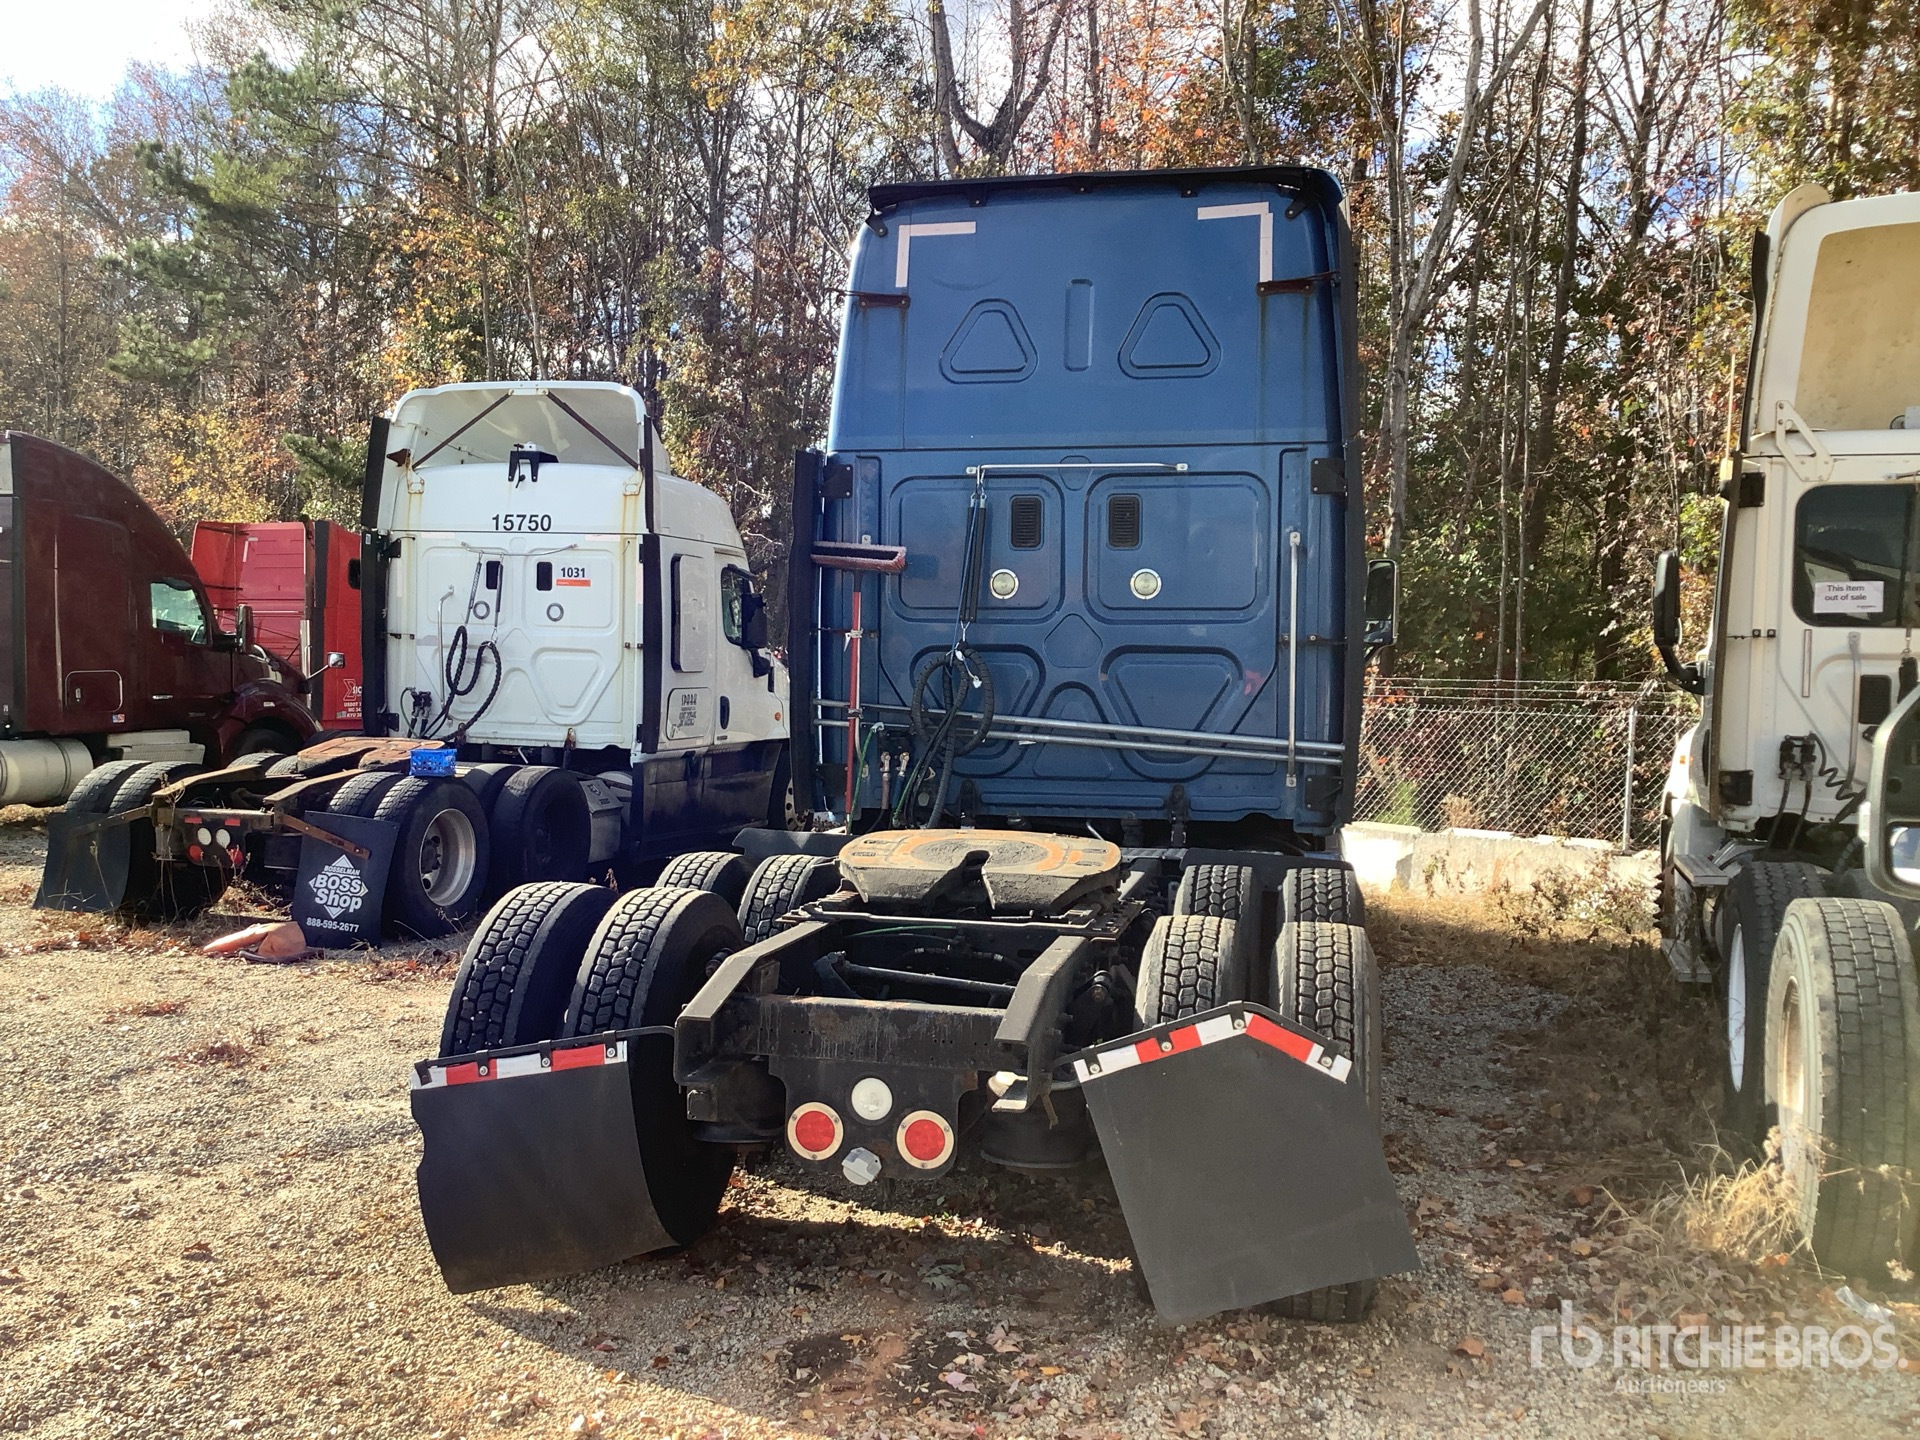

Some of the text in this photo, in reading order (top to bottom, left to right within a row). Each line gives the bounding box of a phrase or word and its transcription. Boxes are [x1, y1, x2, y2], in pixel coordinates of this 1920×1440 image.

[492, 513, 552, 532] 15750
[560, 567, 586, 578] 1031
[324, 865, 360, 875] BOSSELMAN
[314, 888, 363, 913] Shop
[306, 917, 359, 932] 888-595-2677
